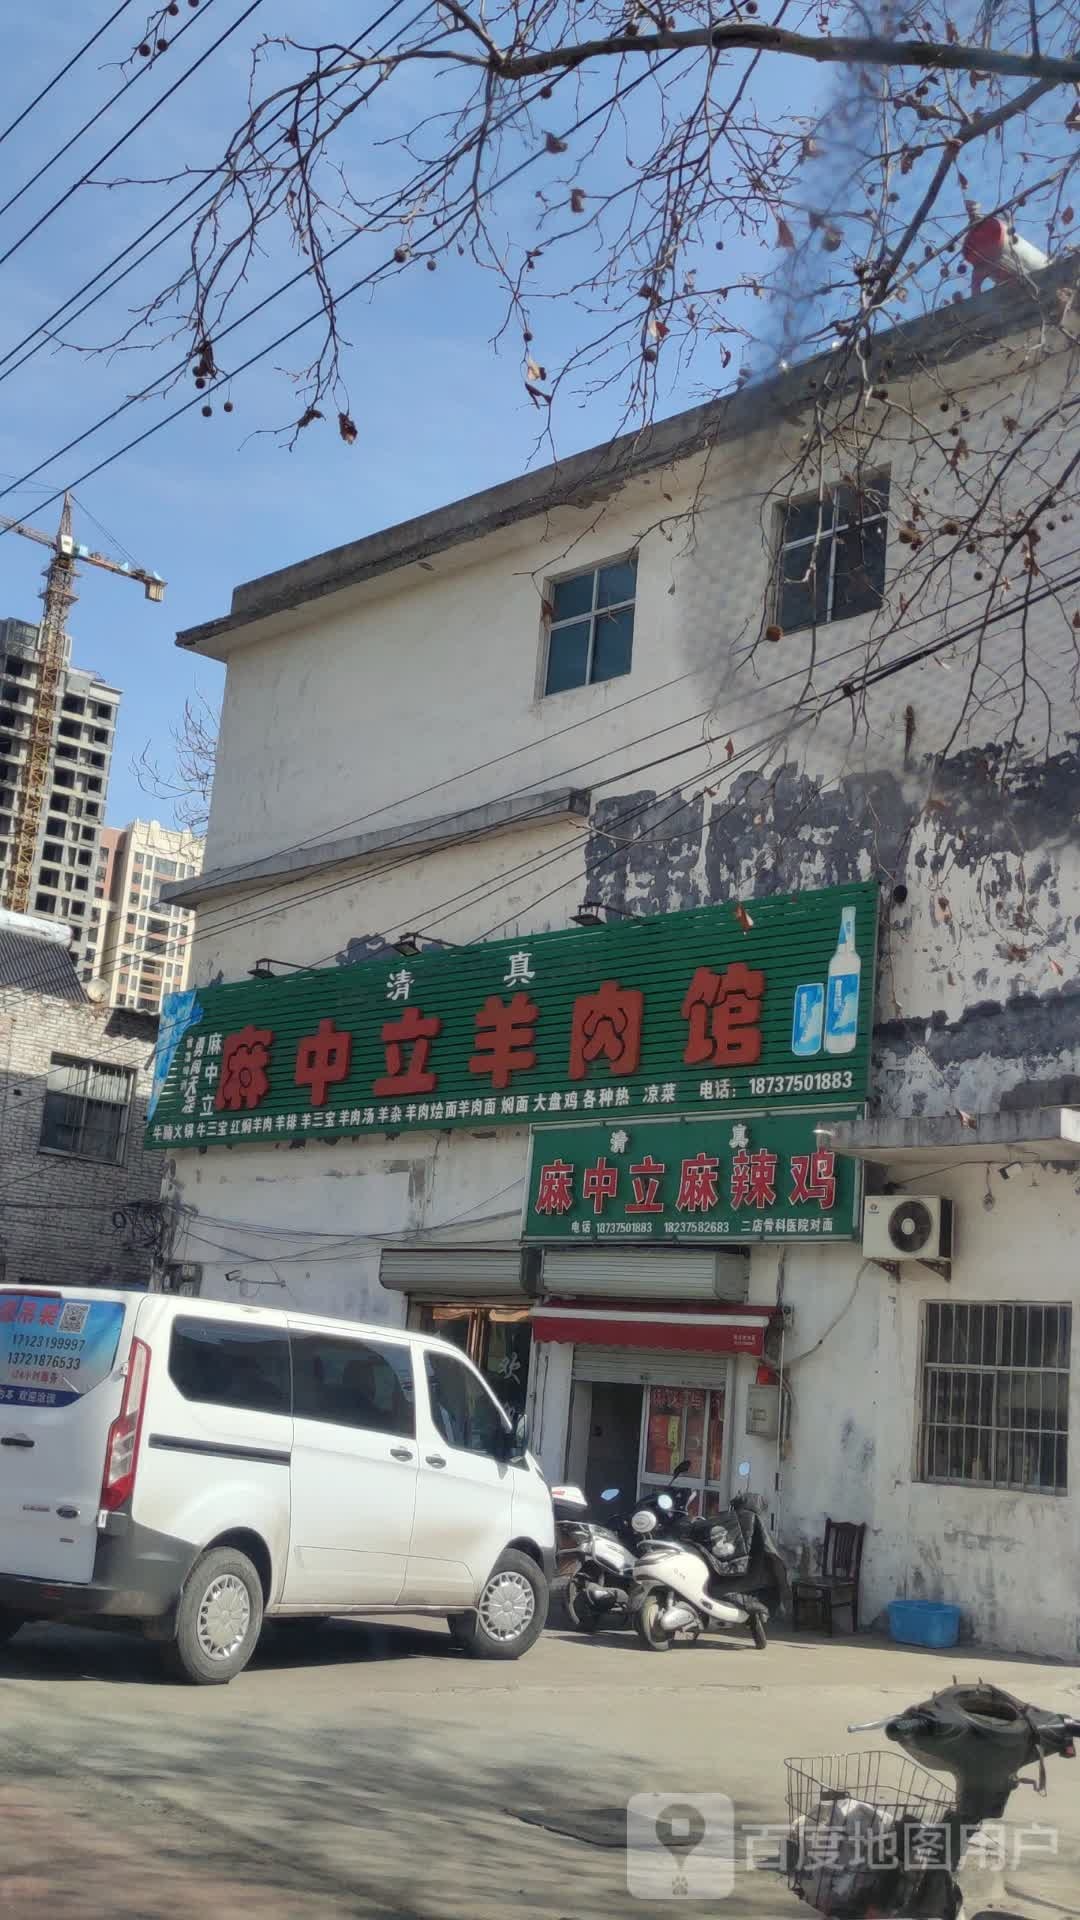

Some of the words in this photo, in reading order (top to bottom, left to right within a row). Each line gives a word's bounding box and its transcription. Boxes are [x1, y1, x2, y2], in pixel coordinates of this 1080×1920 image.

[386, 951, 536, 1001] 清真
[215, 962, 766, 1110] 麻中立羊肉馆
[196, 1120, 228, 1137] 牛三宝
[300, 1111, 336, 1129] 羊三宝
[338, 1107, 374, 1127] 羊肉汤
[533, 1090, 578, 1112] 大盘鸡
[642, 1083, 677, 1103] 凉菜
[749, 1071, 853, 1095] 18737501883
[200, 1033, 223, 1116] 麻中立
[610, 1123, 749, 1153] 清真
[535, 1147, 836, 1214] 麻中立麻辣鸡
[571, 1219, 591, 1234] 电话
[596, 1220, 653, 1234] 18737501883
[741, 1217, 834, 1233] 二店骨科医院对面
